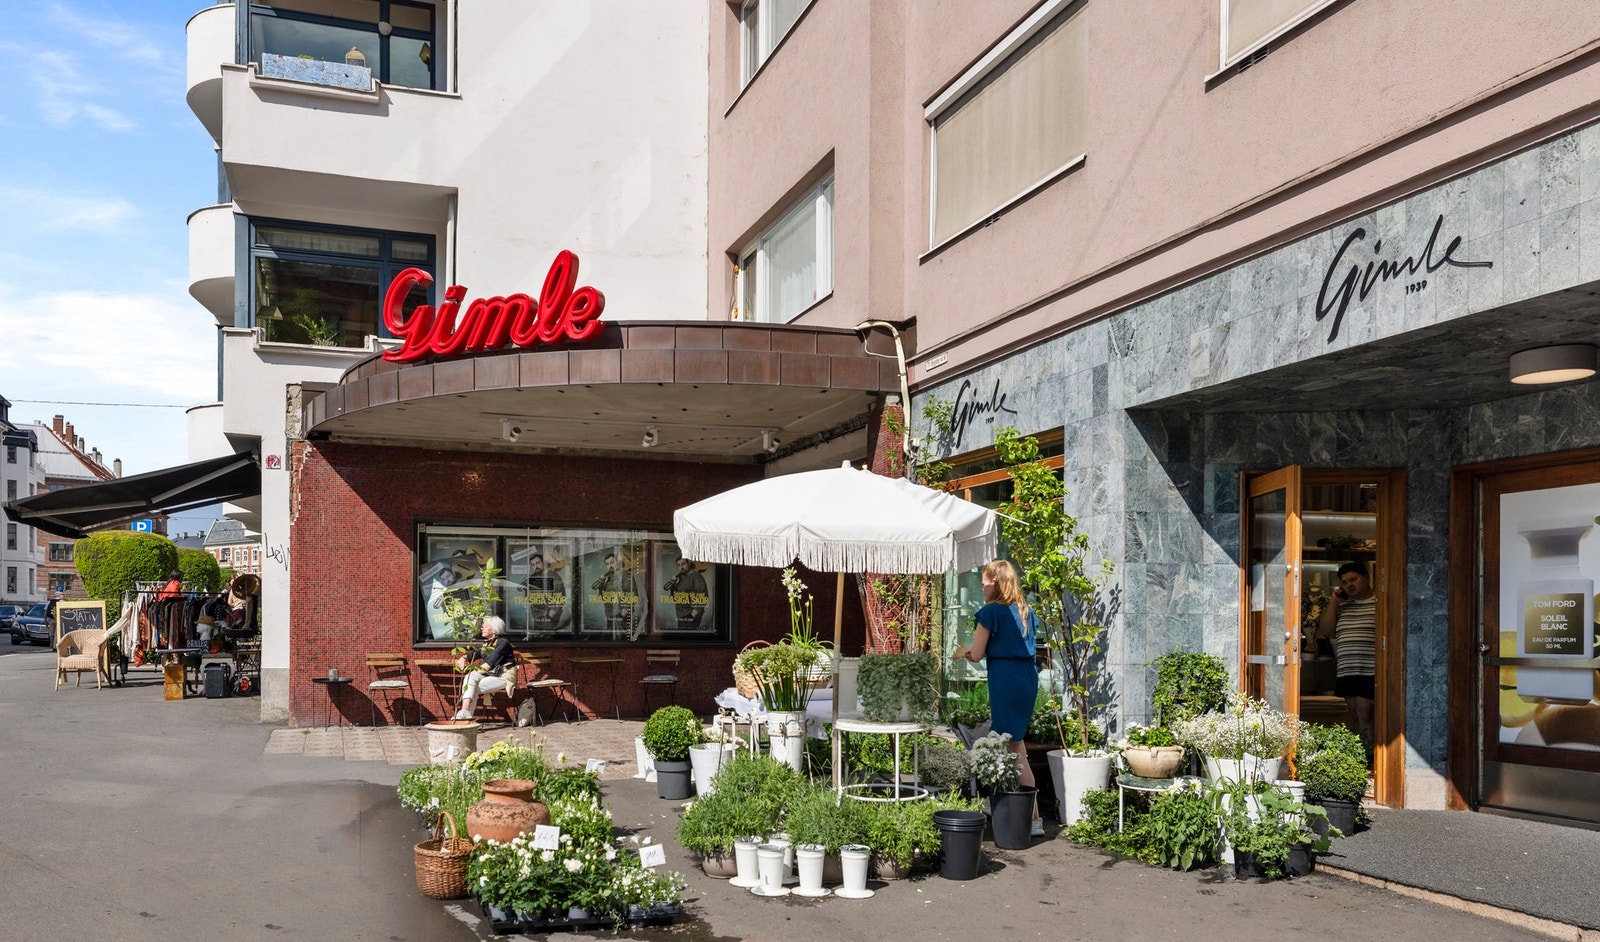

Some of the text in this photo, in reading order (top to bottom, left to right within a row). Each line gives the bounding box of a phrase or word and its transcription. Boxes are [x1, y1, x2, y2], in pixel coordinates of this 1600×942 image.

[1315, 213, 1493, 345] Gimle
[1405, 279, 1428, 296] 1939
[382, 249, 606, 363] Gimle
[951, 378, 1018, 449] Gimle
[136, 521, 147, 532] P
[660, 594, 690, 605] TRASIGA
[1534, 600, 1576, 608] TOM FORD
[1541, 614, 1568, 622] SOLEIL
[1541, 623, 1568, 631] BLANC
